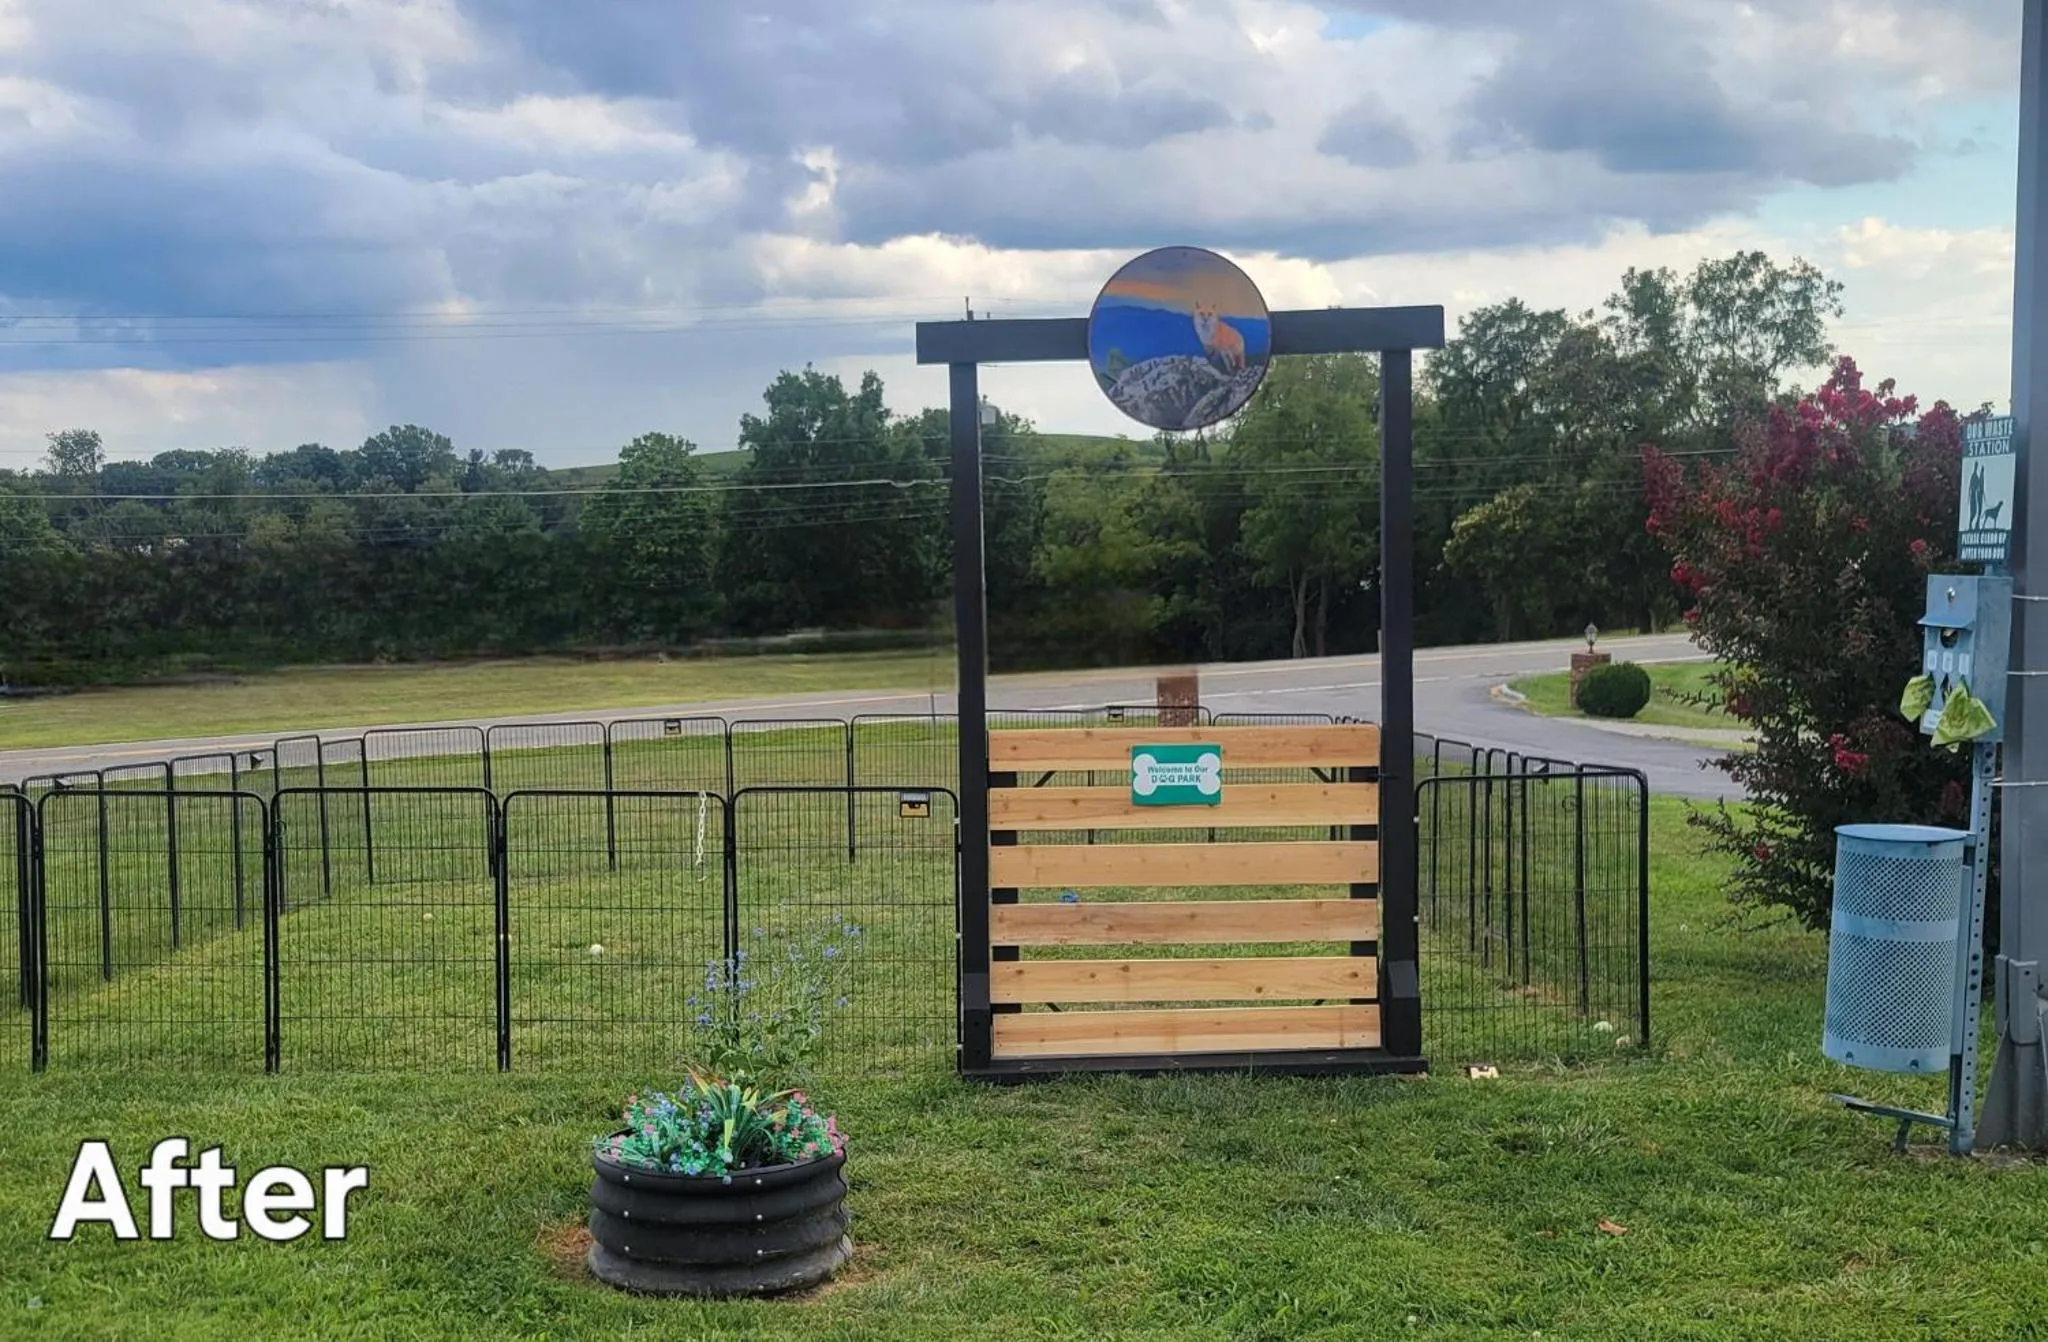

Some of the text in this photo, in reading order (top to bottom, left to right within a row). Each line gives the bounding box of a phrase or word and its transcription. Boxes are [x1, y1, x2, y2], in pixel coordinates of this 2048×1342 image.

[1985, 418, 2013, 437] WASTE
[1969, 439, 2010, 456] STATION
[1147, 765, 1208, 774] Welcome to Our
[1178, 775, 1201, 783] PARK
